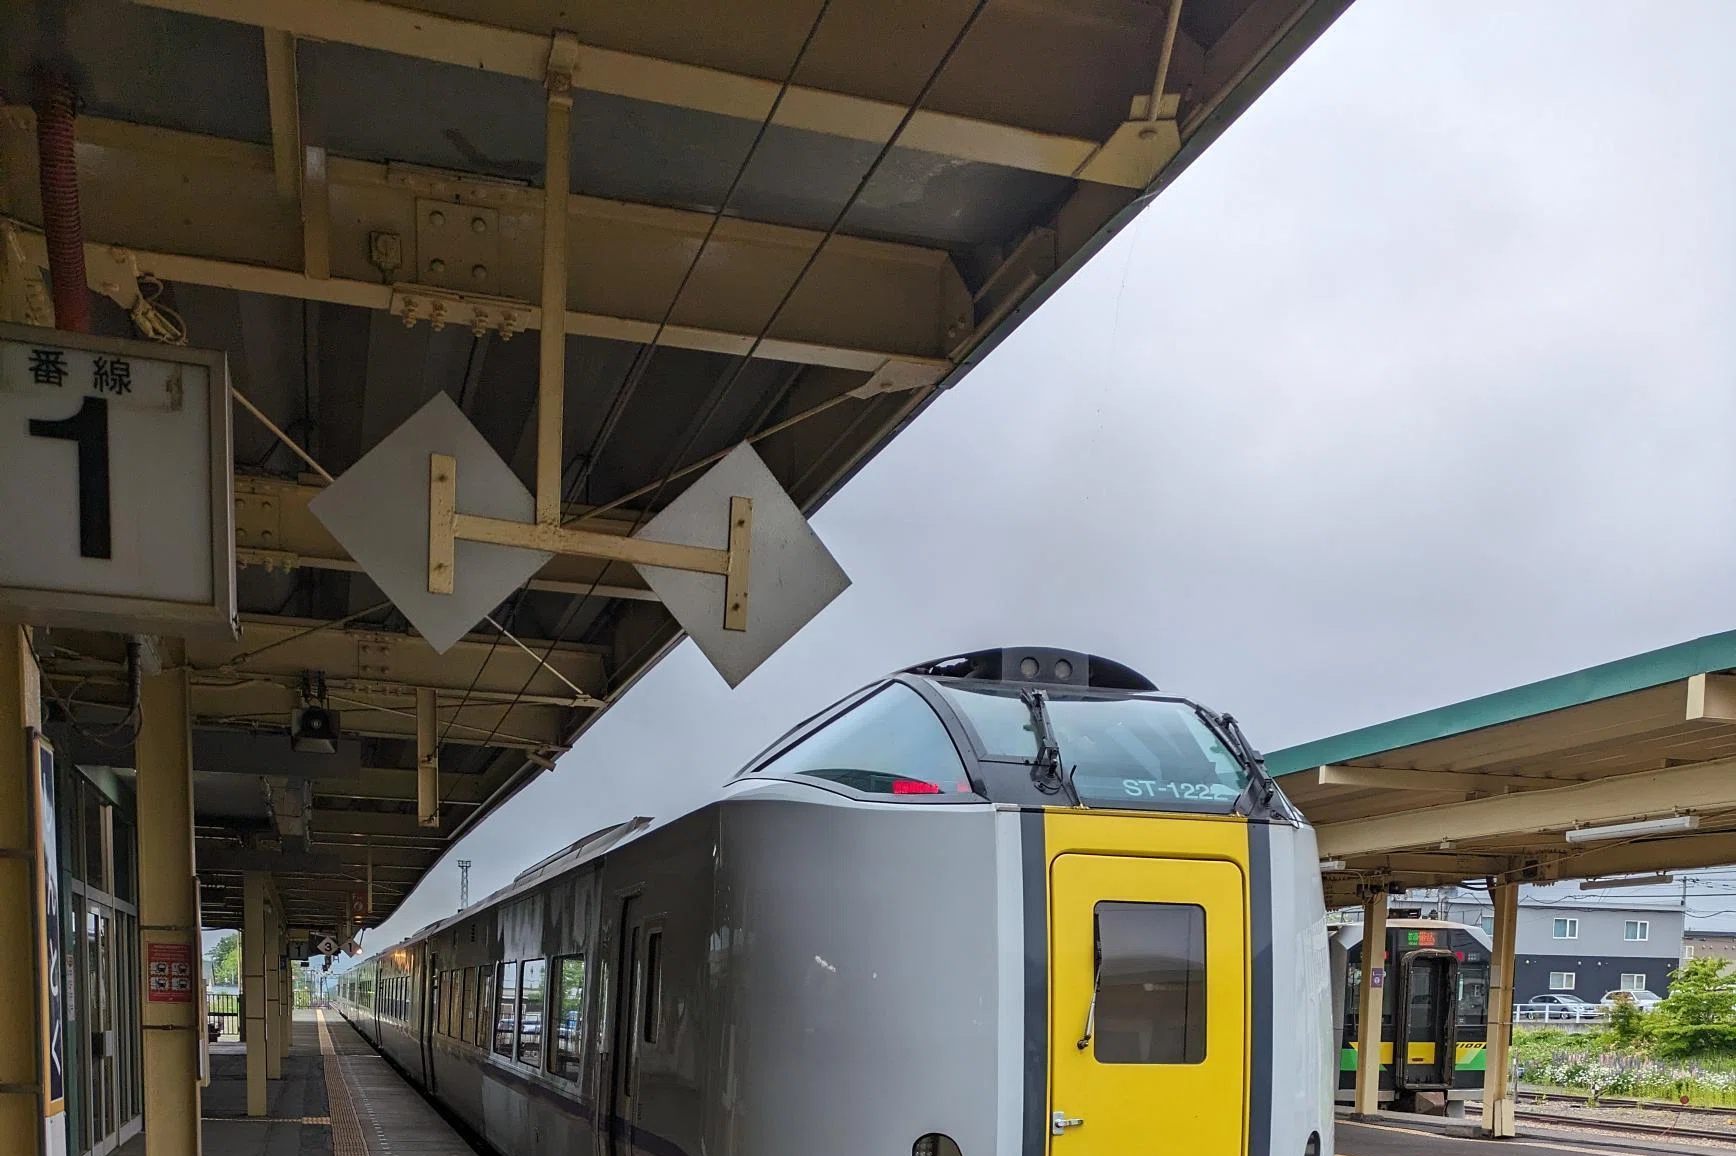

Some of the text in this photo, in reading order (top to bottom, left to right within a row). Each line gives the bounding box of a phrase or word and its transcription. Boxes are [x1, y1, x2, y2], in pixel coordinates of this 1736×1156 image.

[28, 349, 132, 396] 番線
[28, 396, 112, 560] 1
[324, 942, 332, 951] 3
